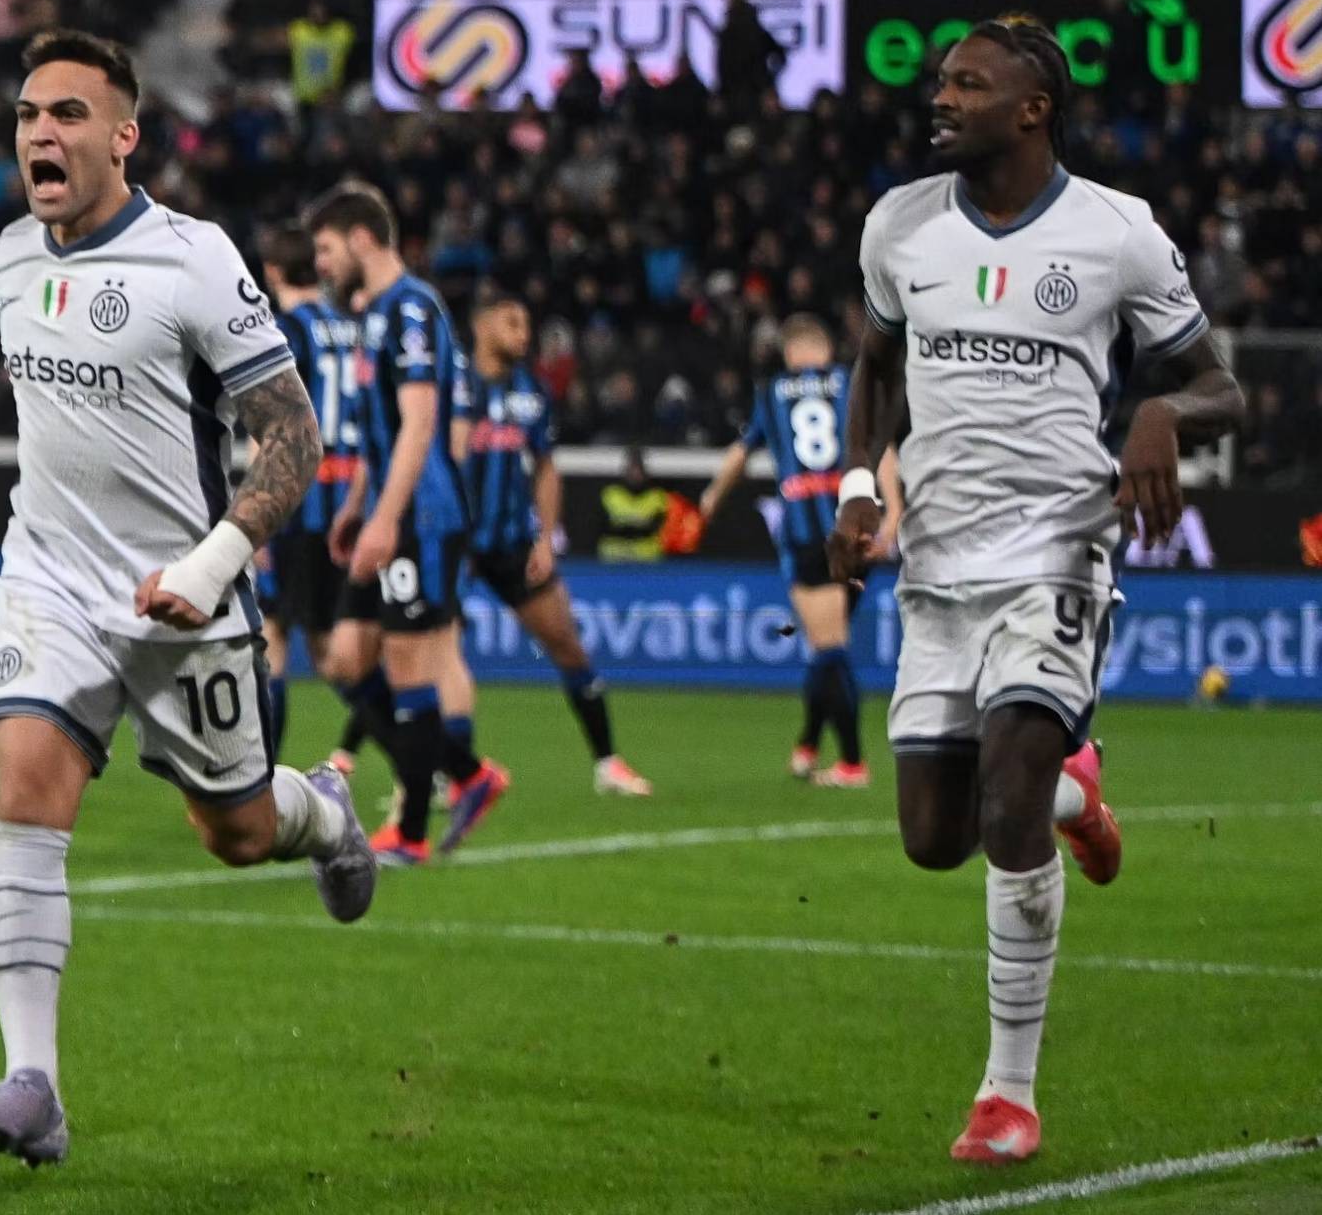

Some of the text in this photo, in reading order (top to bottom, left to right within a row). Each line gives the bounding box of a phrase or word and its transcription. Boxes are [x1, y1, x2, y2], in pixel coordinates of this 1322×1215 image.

[3, 346, 124, 390] etsson
[790, 397, 840, 471] 8
[175, 672, 242, 736] 10
